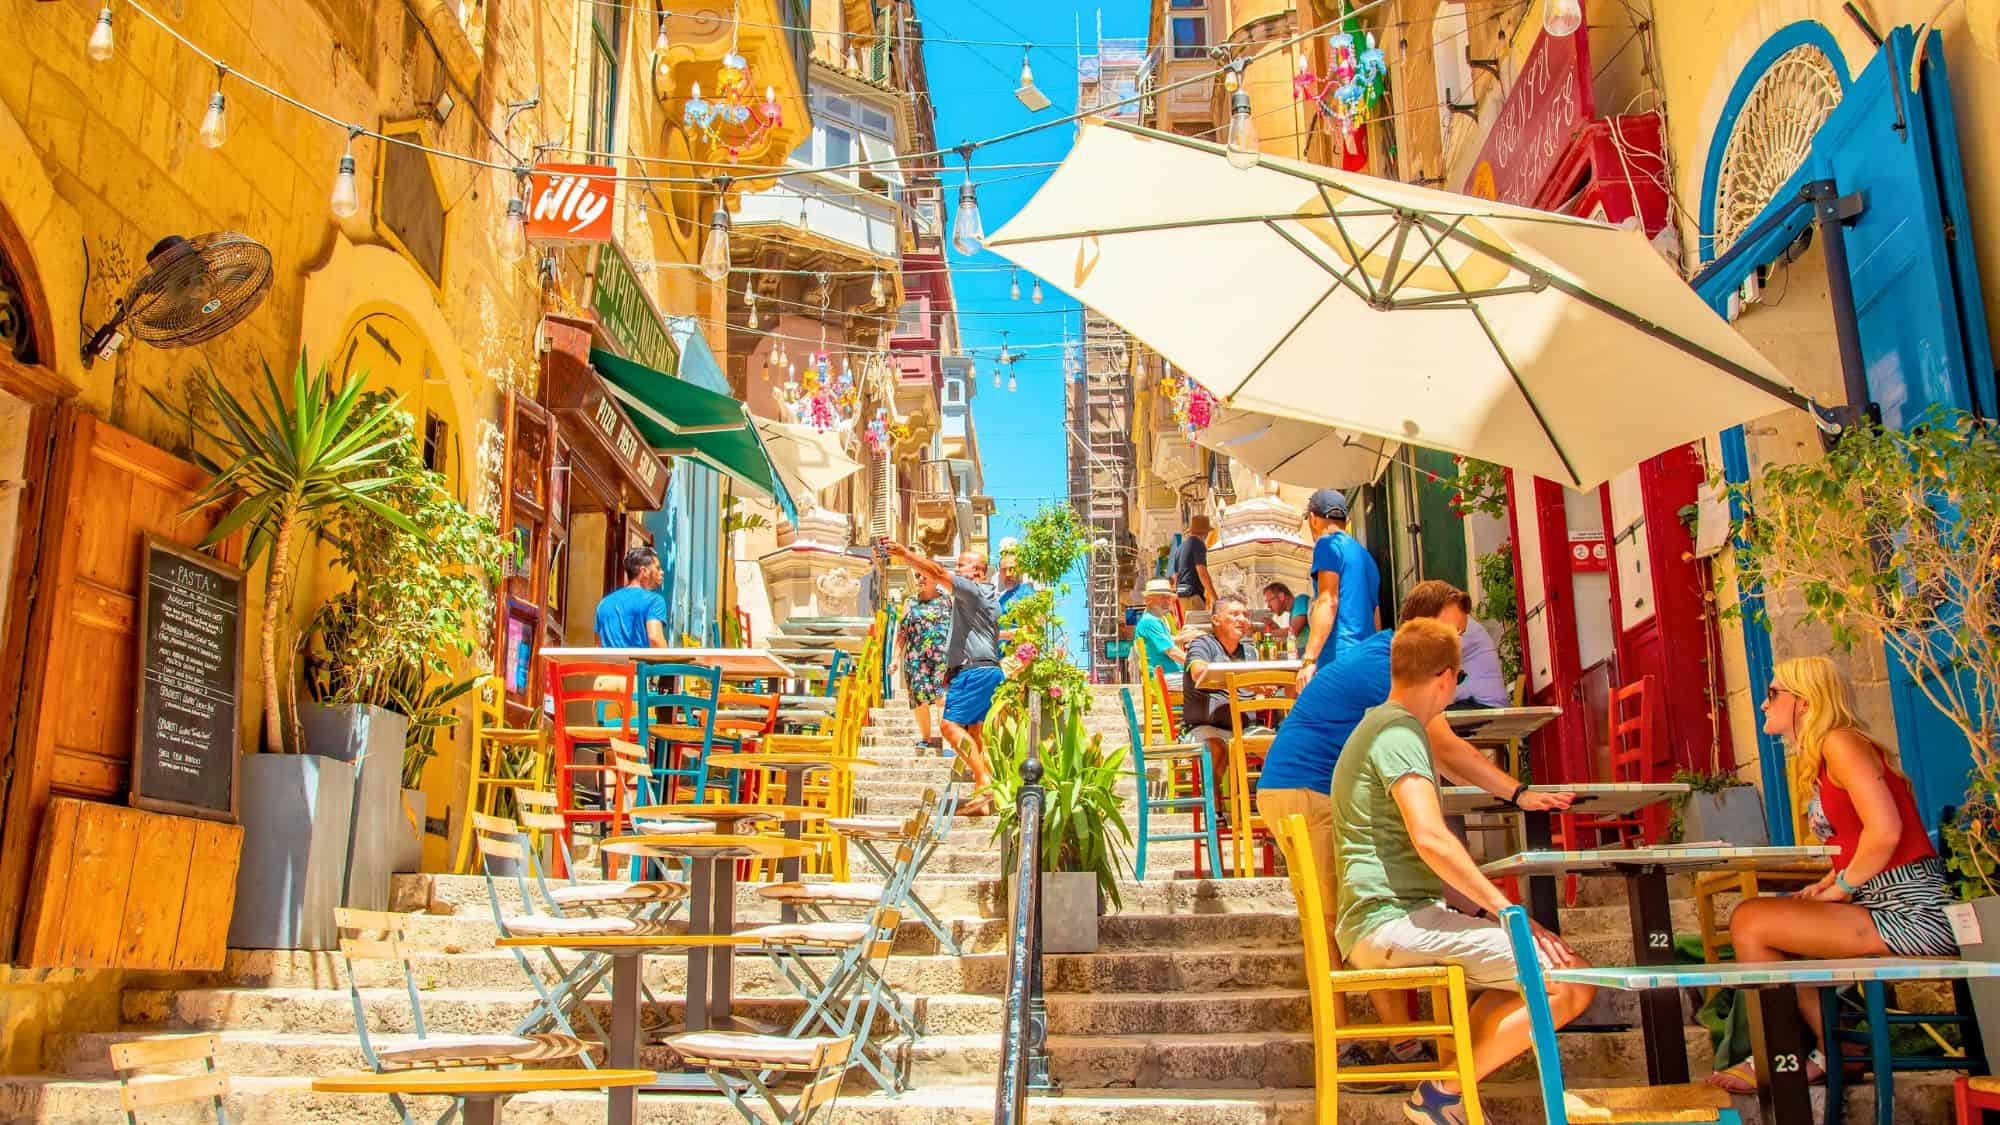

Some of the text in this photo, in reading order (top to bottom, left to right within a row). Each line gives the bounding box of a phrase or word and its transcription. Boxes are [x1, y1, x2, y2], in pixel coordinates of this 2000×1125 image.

[533, 174, 609, 233] illy
[595, 396, 618, 438] PIZZA
[616, 423, 638, 464] PASTA
[177, 565, 210, 592] PASTA
[1649, 933, 1669, 948] 22
[1774, 1054, 1800, 1073] 23
